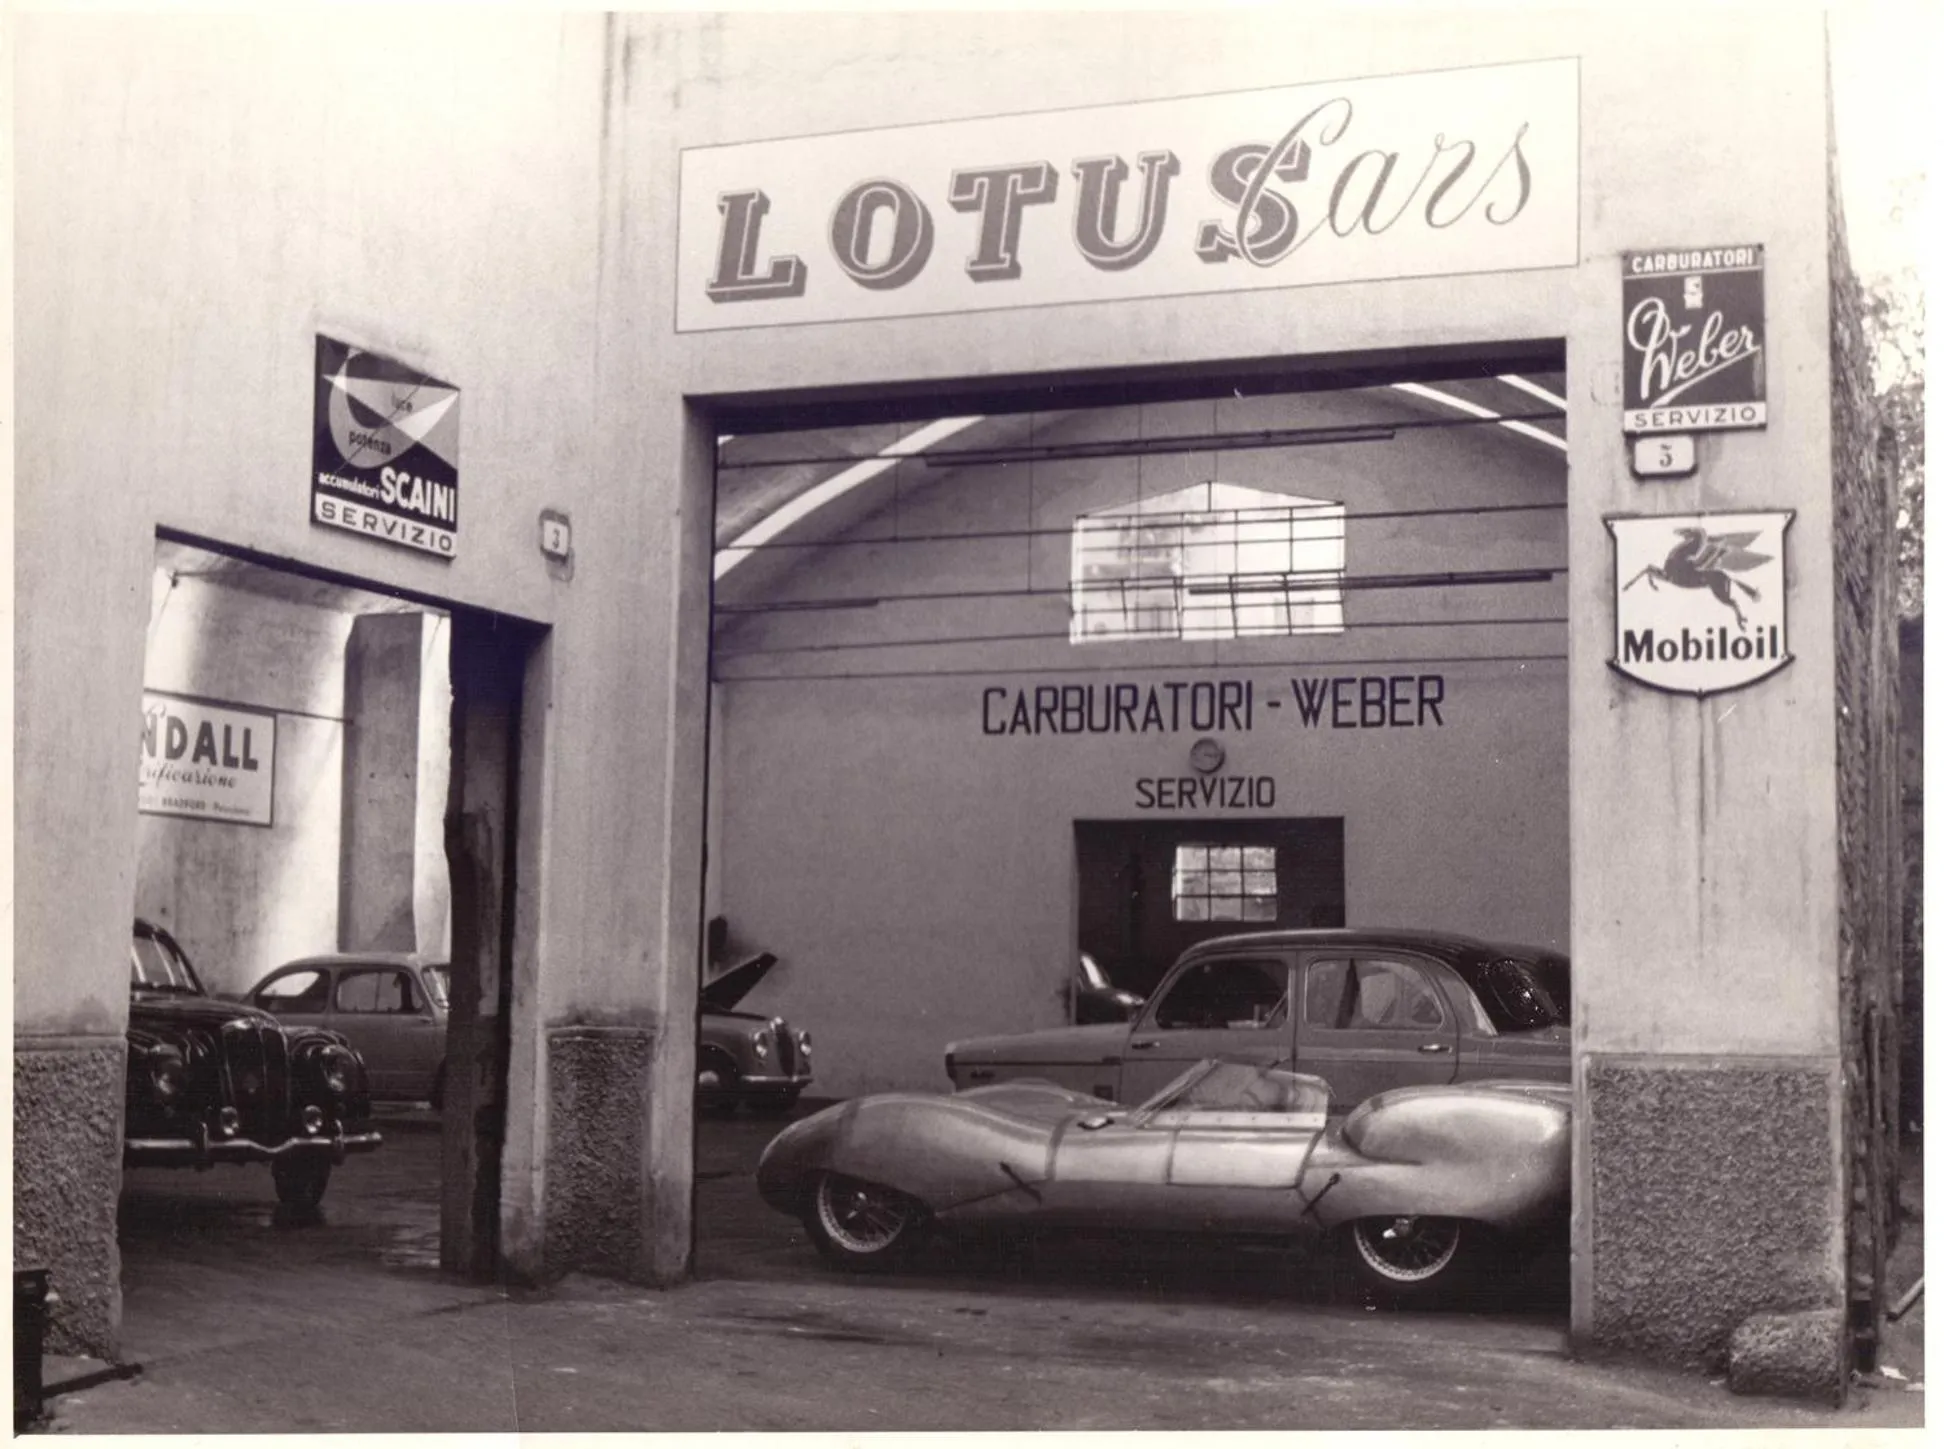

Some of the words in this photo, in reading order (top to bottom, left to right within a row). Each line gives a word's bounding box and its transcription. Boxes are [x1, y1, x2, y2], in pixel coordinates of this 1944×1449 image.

[705, 139, 1312, 304] LOTUS
[1237, 96, 1534, 267] Cars
[1632, 248, 1753, 272] CARBURATORI
[1627, 297, 1761, 400] Weber
[1634, 406, 1756, 428] SERVIZIO
[318, 471, 380, 499] accumulatori
[380, 466, 455, 522] SCAINI
[321, 501, 452, 552] SERVIZIO
[1624, 625, 1778, 664] Mobiloil
[982, 681, 1253, 736] CARBURATORI
[1292, 675, 1445, 729] WEBER
[1136, 777, 1276, 808] SERVIZIO
